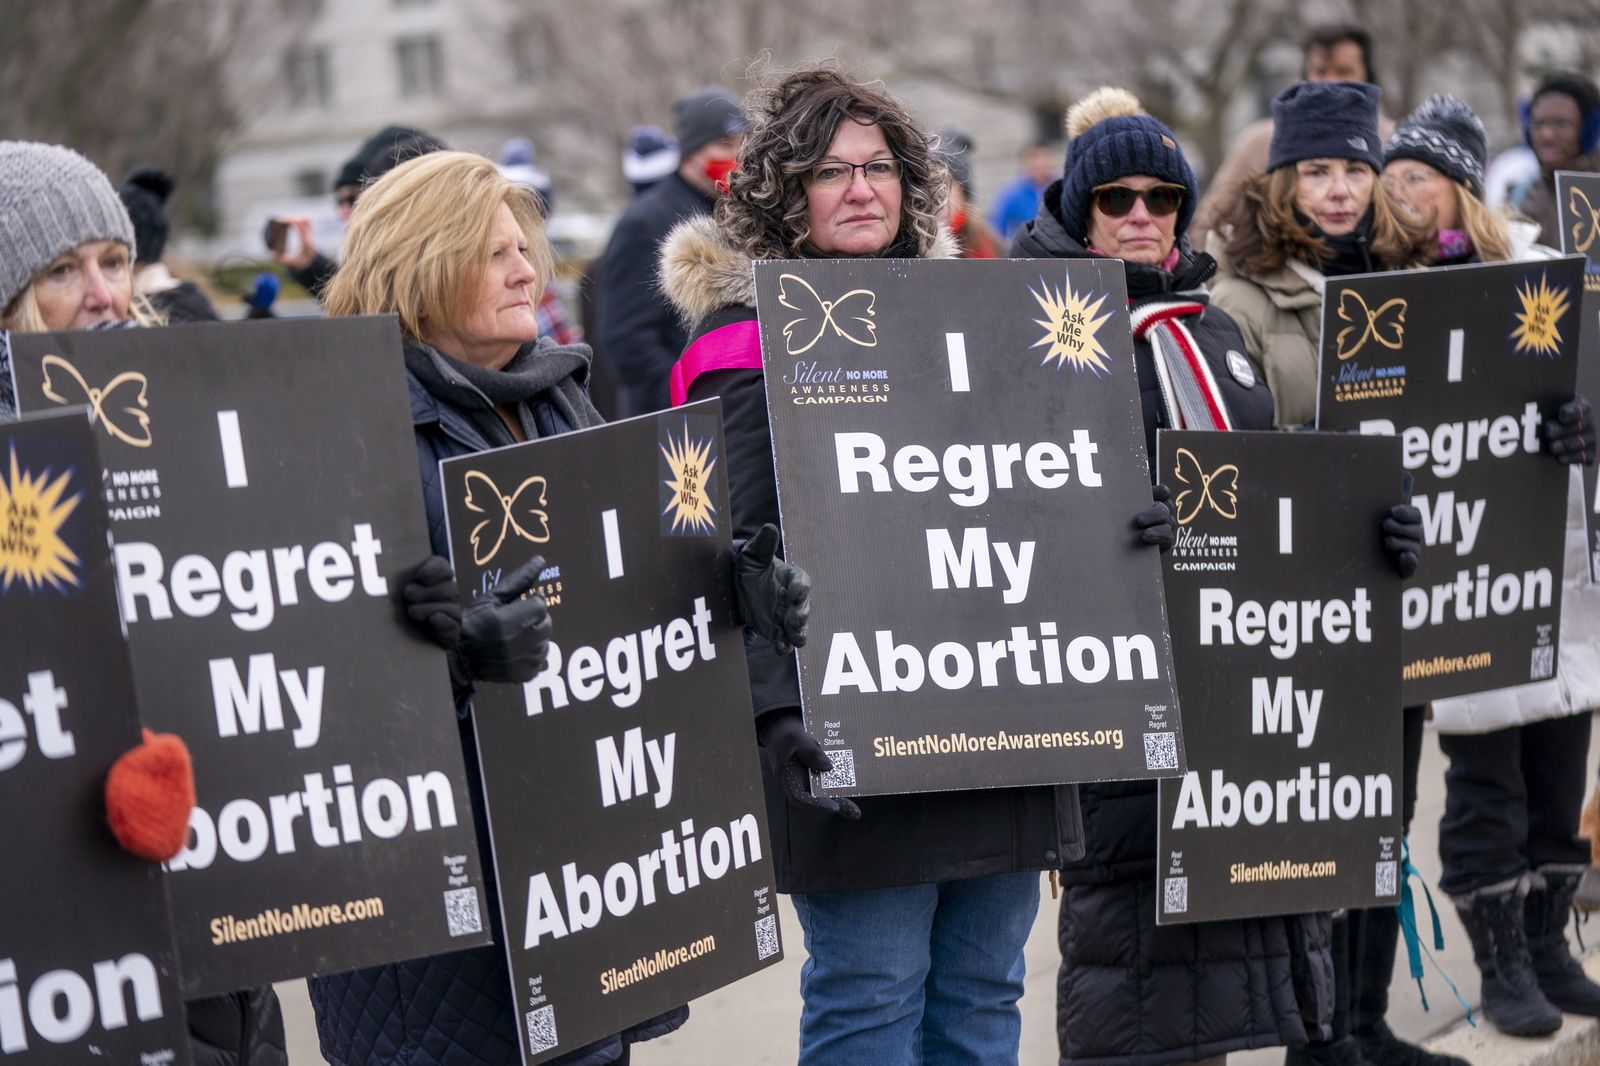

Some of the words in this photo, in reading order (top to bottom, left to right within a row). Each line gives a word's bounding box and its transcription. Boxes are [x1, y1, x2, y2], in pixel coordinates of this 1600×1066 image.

[1062, 309, 1085, 326] Ask
[1062, 321, 1081, 336] Me
[1057, 332, 1084, 352] Why
[945, 332, 971, 393] I
[1447, 329, 1465, 382] I
[783, 360, 845, 384] Silent
[846, 370, 861, 380] NO
[862, 370, 888, 380] MORE
[791, 384, 890, 394] AWARENESS
[792, 396, 888, 405] CAMPAIGN
[1336, 387, 1403, 402] CAMPAIGN
[216, 409, 249, 489] I
[112, 470, 130, 486] NO
[130, 468, 159, 485] MORE
[683, 464, 698, 479] Ask
[833, 429, 1103, 508] Regret
[106, 485, 162, 502] ENESS
[684, 478, 697, 492] Me
[8, 501, 39, 519] Ask
[108, 504, 161, 520] AIGN
[680, 490, 698, 510] Why
[8, 520, 36, 537] Me
[1278, 497, 1293, 554] I
[1411, 491, 1486, 556] My
[0, 535, 42, 560] Why
[601, 508, 625, 580] I
[1171, 526, 1208, 548] Silent
[1210, 536, 1220, 546] NO
[1220, 536, 1238, 546] MORE
[1172, 548, 1238, 556] AWARENESS
[114, 522, 389, 632] Regret
[925, 526, 1037, 605] My
[1173, 562, 1236, 571] CAMPAIGN
[1402, 564, 1553, 630] ortion
[1199, 587, 1372, 660] Regret
[523, 596, 717, 717] Regret
[820, 621, 1160, 696] Abortion
[1402, 652, 1492, 680] ntNoMore.com
[208, 652, 326, 749] My
[1144, 704, 1167, 712] Register
[1251, 676, 1324, 748] My
[1148, 720, 1167, 730] Regret
[1150, 712, 1163, 720] Your
[873, 729, 1124, 758] SilentNoMoreAwareness.org
[595, 726, 676, 809] My
[1171, 762, 1393, 830] Abortion
[162, 764, 458, 871] bortion
[524, 813, 762, 950] Abortion
[1230, 859, 1337, 884] SilentNoMore.com
[210, 896, 385, 945] SilentNoMore.com
[600, 934, 716, 995] SilentNoMore.com
